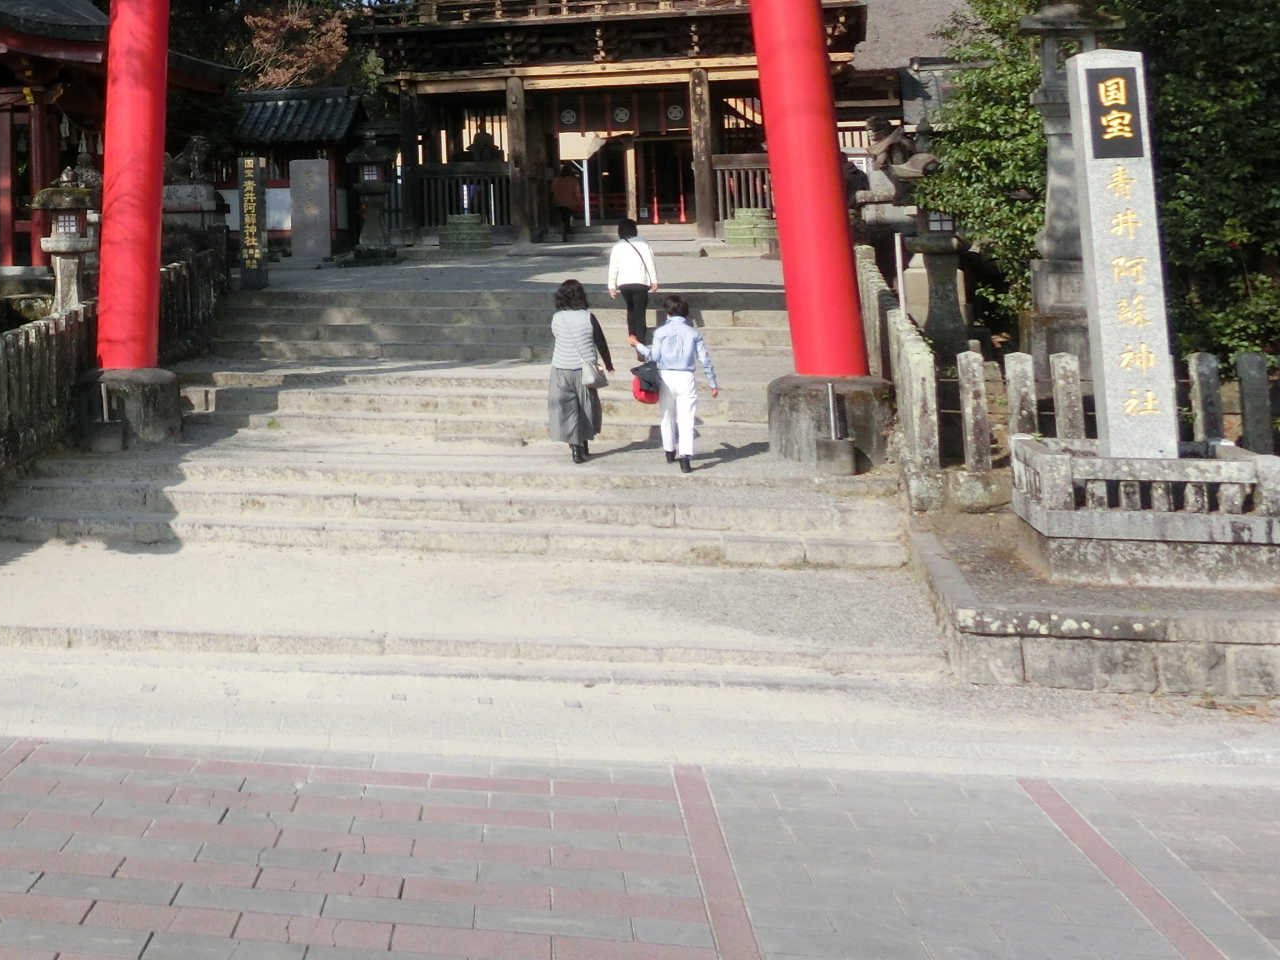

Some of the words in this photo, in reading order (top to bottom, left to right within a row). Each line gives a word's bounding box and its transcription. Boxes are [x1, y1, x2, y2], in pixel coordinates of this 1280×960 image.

[1097, 77, 1134, 140] 国宝
[243, 180, 258, 246] 青井阿蘇神社
[1106, 163, 1162, 417] 青井阿蘇神社
